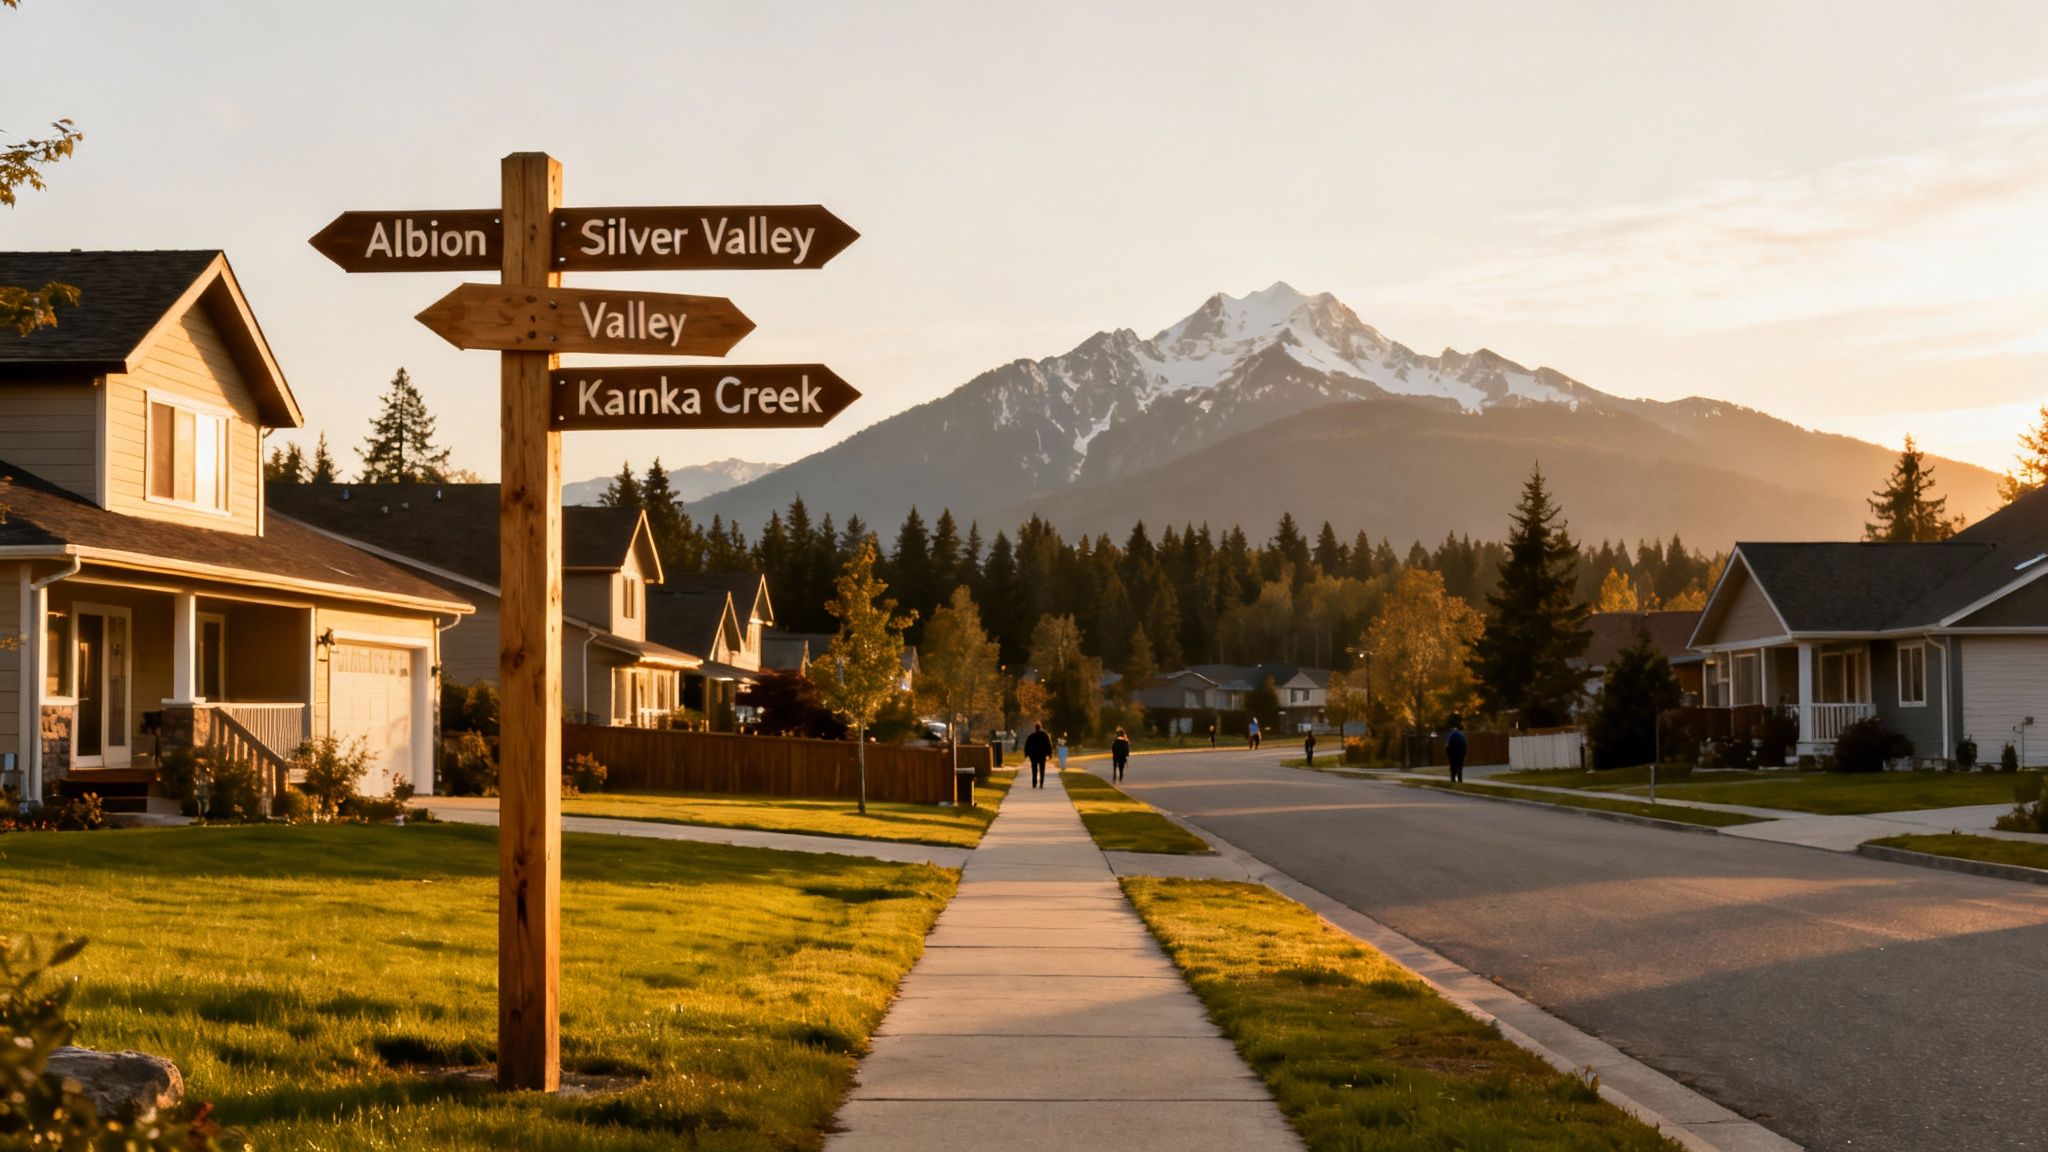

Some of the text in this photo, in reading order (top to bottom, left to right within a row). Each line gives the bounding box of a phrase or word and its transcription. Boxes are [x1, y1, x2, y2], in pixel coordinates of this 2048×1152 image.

[365, 218, 487, 258] Albion
[580, 216, 816, 265] Silver Valley
[580, 301, 687, 347] Valley
[715, 375, 823, 414] Creek
